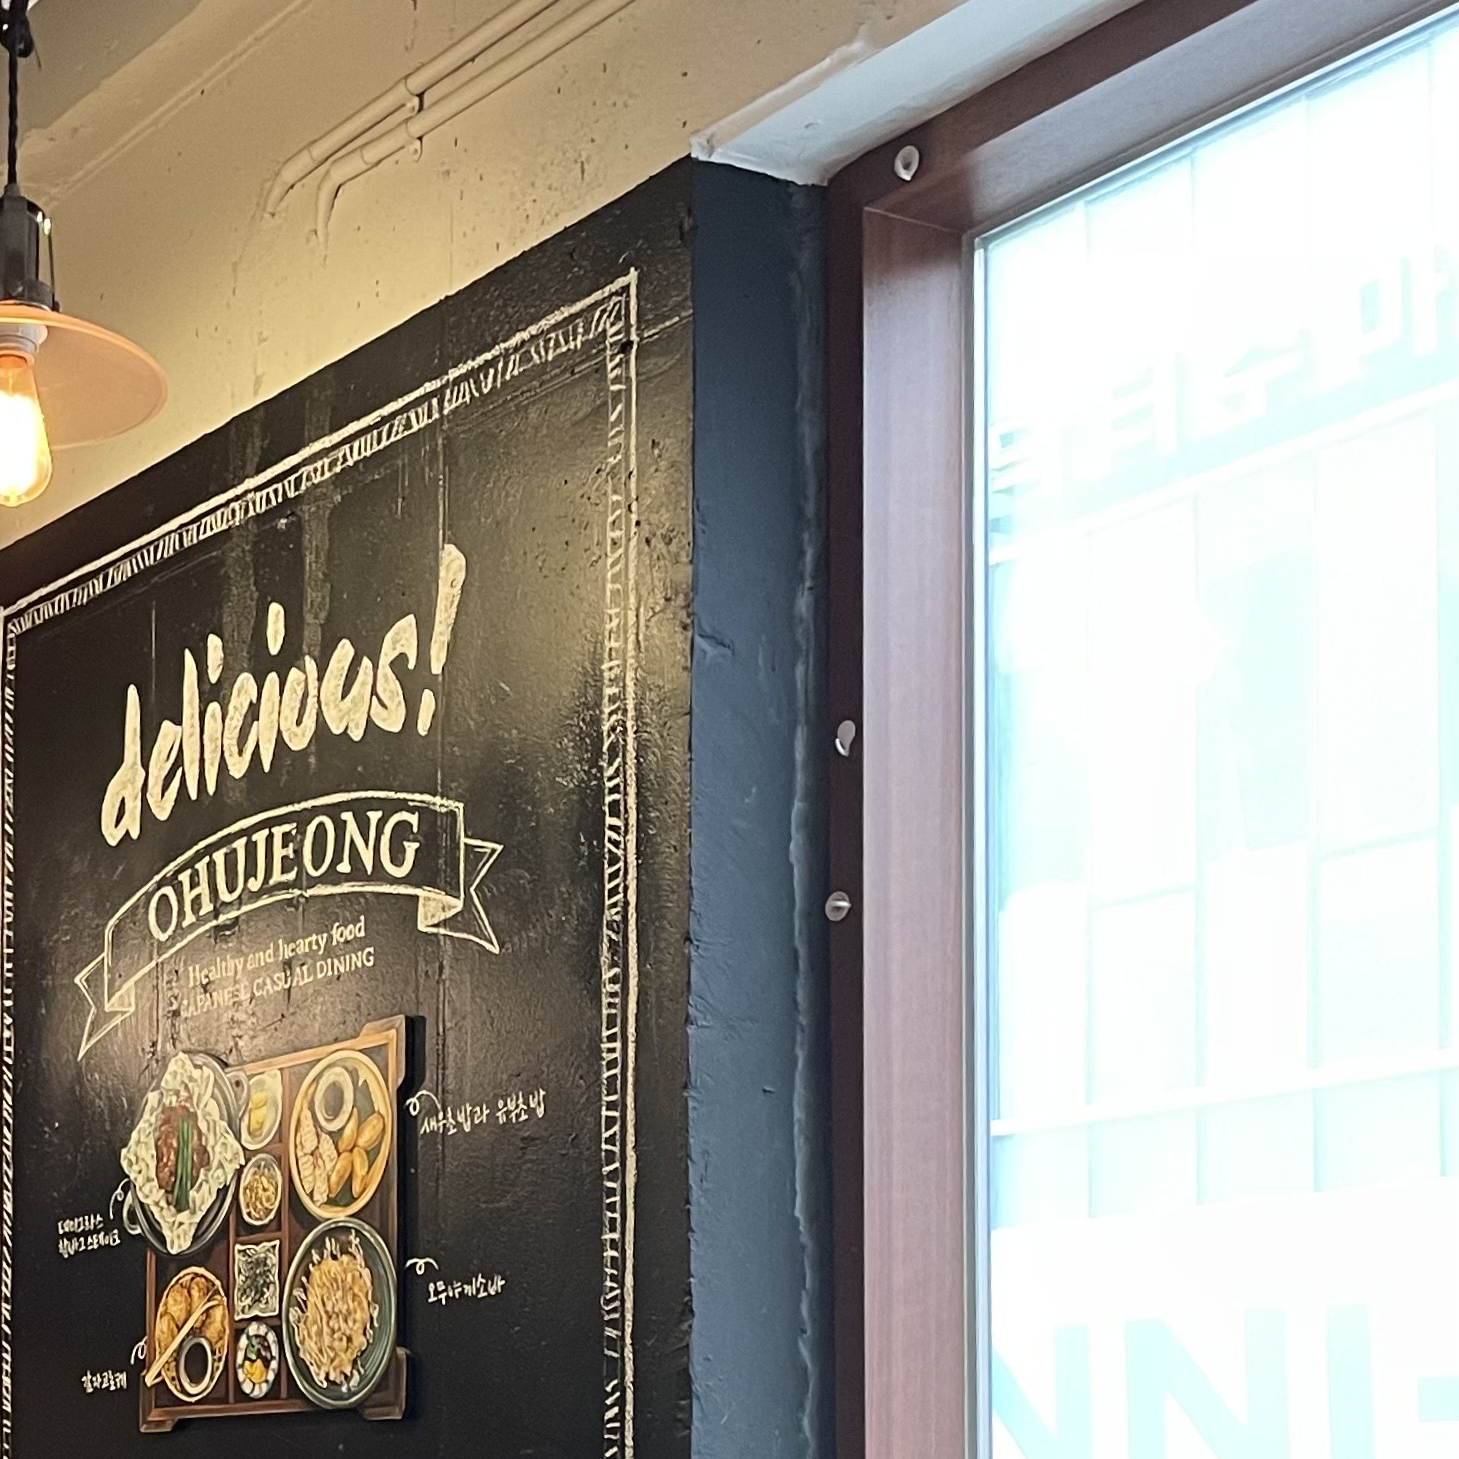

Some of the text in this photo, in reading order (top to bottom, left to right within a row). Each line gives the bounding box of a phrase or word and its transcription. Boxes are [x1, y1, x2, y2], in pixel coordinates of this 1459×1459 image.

[100, 544, 467, 847] delicious!
[147, 810, 420, 942] OHUJEONG
[188, 914, 366, 988] Healthy and hearty food
[252, 964, 314, 998] CASUAL
[315, 946, 375, 980] DINING
[420, 1087, 547, 1136] 새우초밥과 유부초밥
